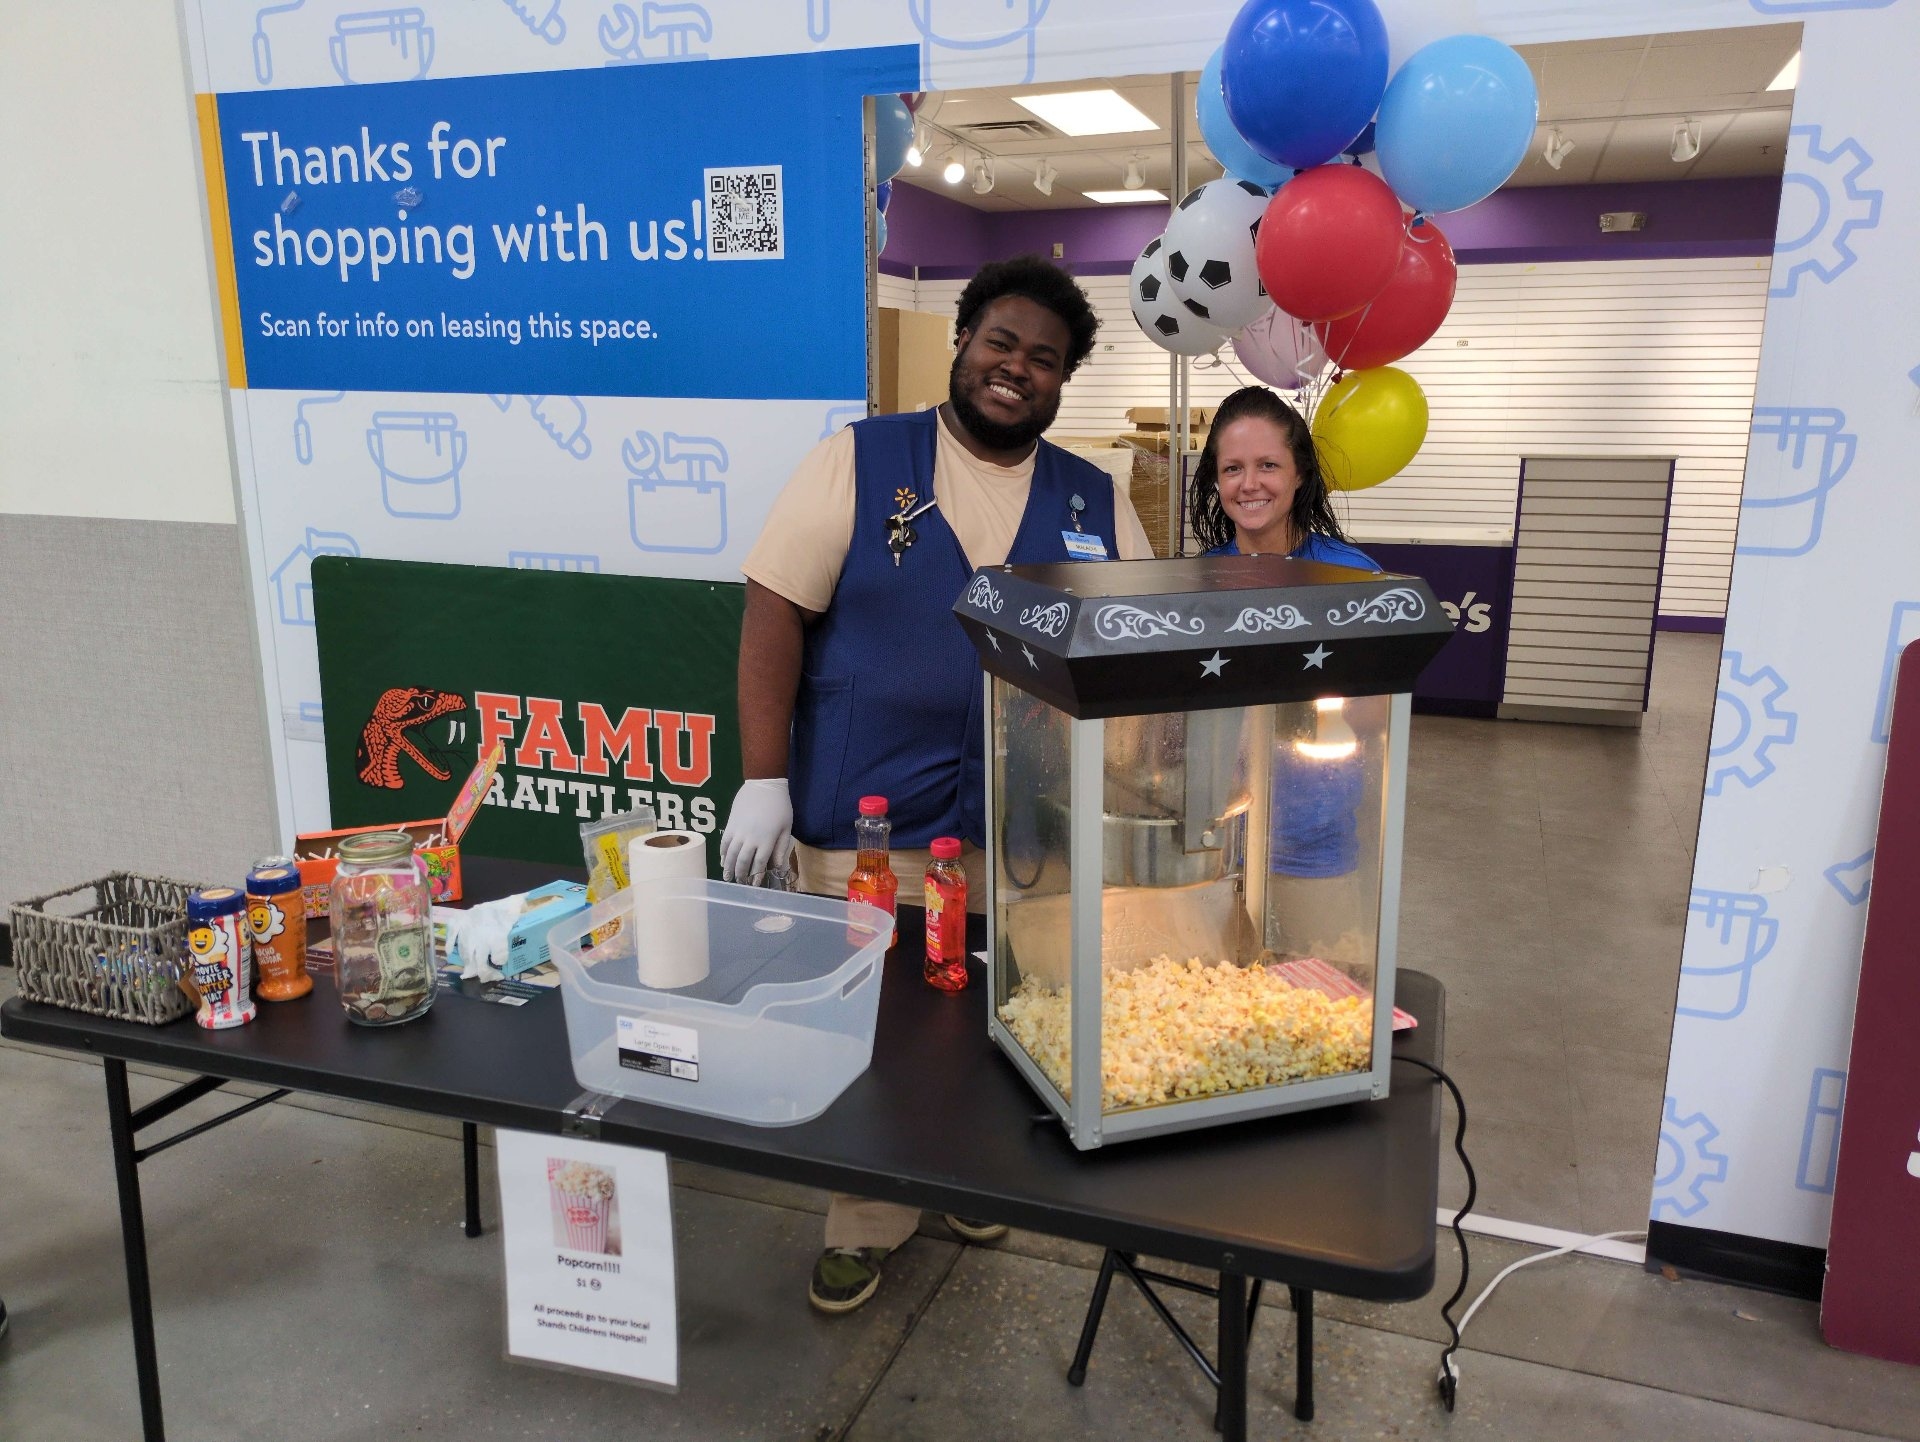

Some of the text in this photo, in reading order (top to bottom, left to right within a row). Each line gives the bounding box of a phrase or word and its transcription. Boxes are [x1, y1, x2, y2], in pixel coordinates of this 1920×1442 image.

[241, 121, 507, 187] Thanks for
[252, 199, 706, 283] shopping with us!
[260, 311, 658, 347] Scan for info on leasing this space.
[474, 691, 716, 788] FAMU
[480, 772, 717, 834] RATTLERS
[557, 1255, 621, 1273] Popcorn!!!!
[576, 1277, 587, 1288] $1
[534, 1304, 650, 1330] All proceeds go to your local
[537, 1318, 567, 1331] Shands
[568, 1324, 607, 1337] Childrens
